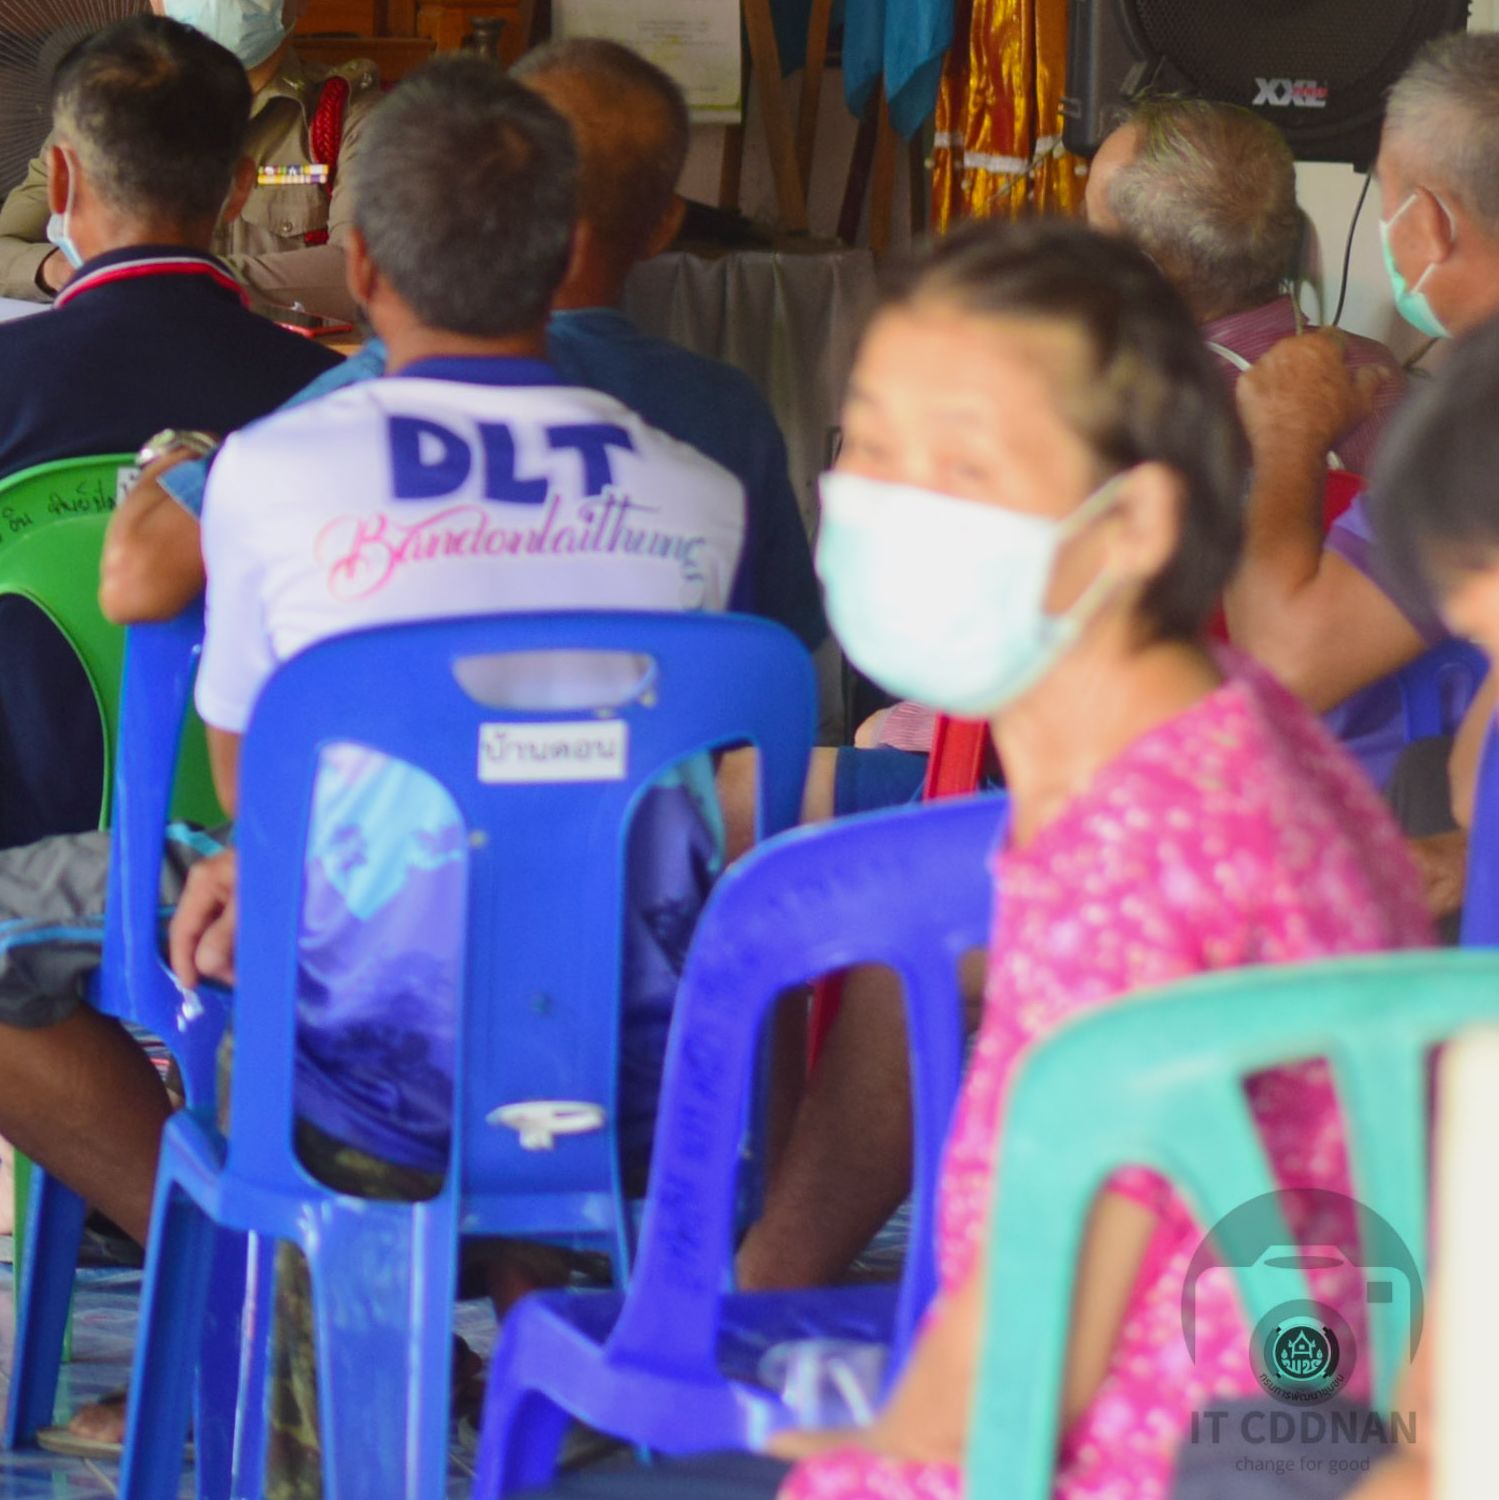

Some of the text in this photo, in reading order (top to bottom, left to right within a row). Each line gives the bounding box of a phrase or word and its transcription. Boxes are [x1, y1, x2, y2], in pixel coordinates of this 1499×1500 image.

[387, 413, 643, 507] DLT
[484, 731, 617, 763] บ้านดอน
